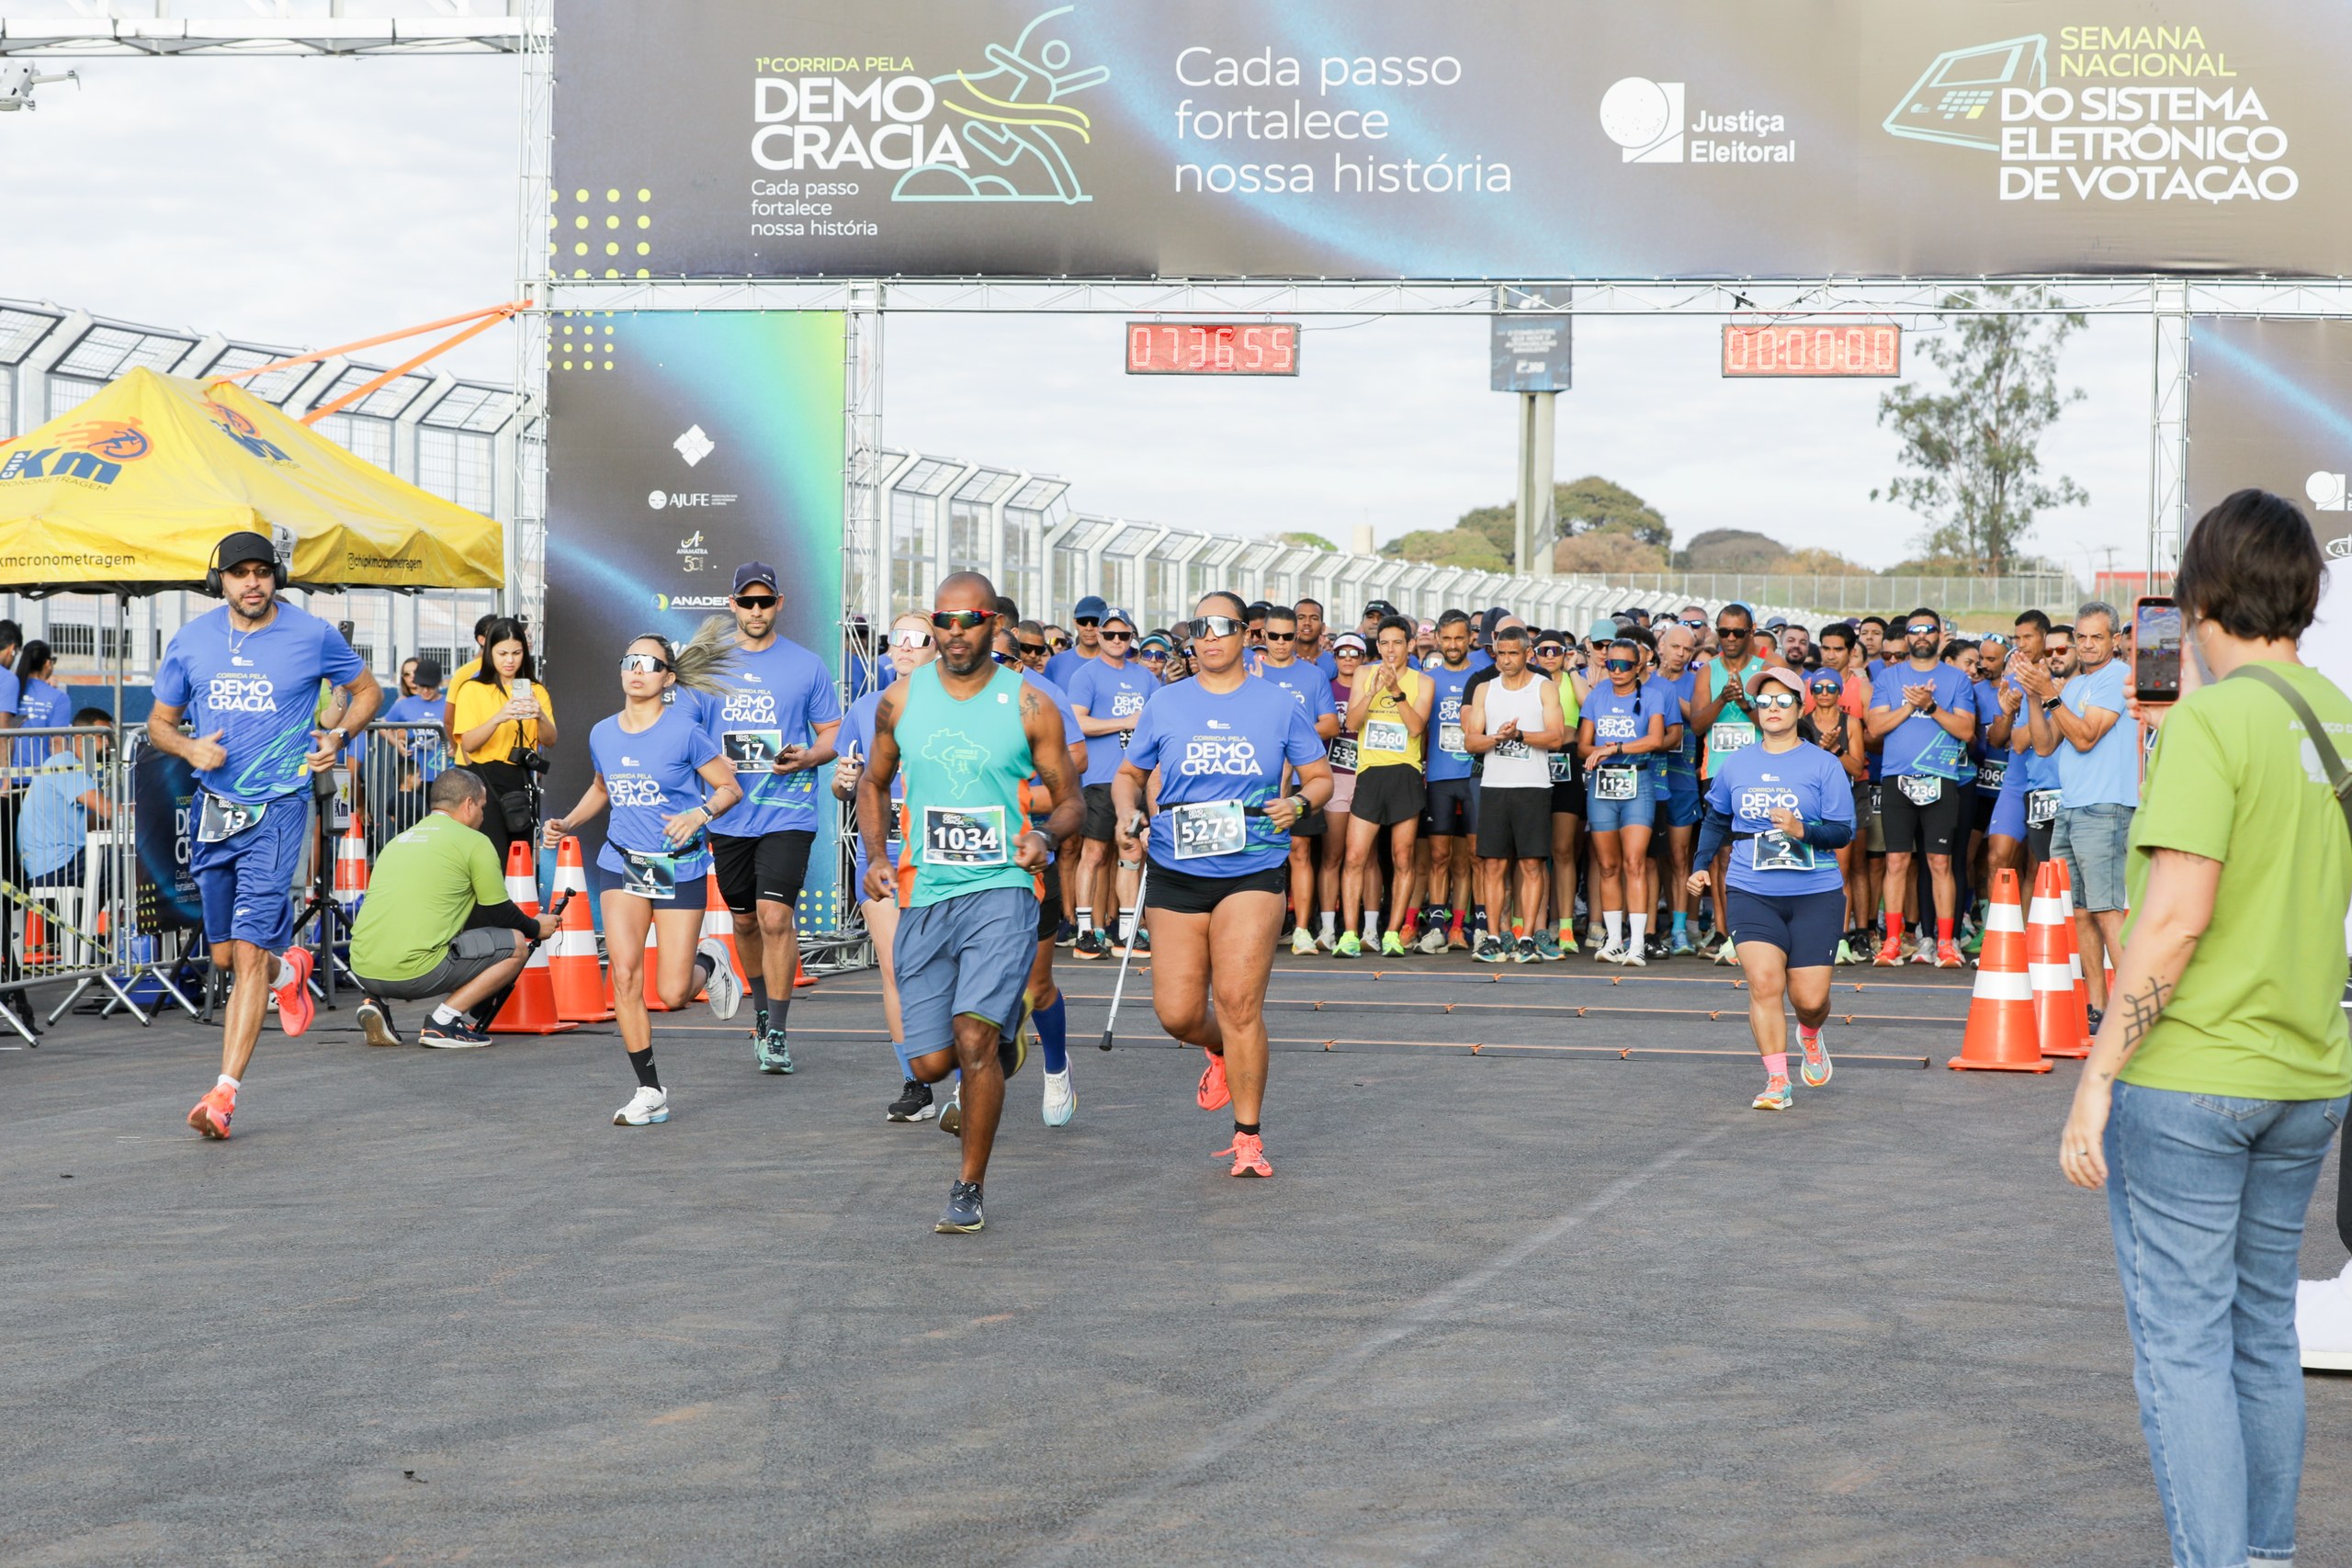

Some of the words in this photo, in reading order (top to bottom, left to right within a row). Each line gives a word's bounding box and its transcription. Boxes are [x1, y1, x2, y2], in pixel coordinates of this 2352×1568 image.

[2060, 26, 2205, 51] SEMANA
[865, 56, 915, 73] PELA
[1175, 46, 1301, 87] Cada
[1320, 54, 1462, 96] passo
[2059, 52, 2237, 77] NACIONAL
[754, 76, 935, 123] DEMO
[2001, 87, 2075, 121] DO
[2081, 87, 2269, 121] SISTEMA
[1175, 99, 1389, 140] fortalece
[1691, 110, 1785, 138] Justiça
[751, 124, 970, 171] CRACIA
[1690, 140, 1795, 163] Eleitoral
[2001, 123, 2289, 162] ELETRÔNICO
[1175, 164, 1314, 194] nossa
[1334, 152, 1512, 193] história
[1999, 166, 2060, 200] DE
[2066, 157, 2299, 204] VOTAÇÃO
[751, 179, 799, 196] Cada
[805, 183, 860, 200] passo
[751, 199, 832, 216] fortalece
[751, 222, 805, 235] nossa
[809, 219, 878, 235] história
[1728, 330, 1894, 369] 00:00:00
[670, 493, 710, 508] AJUFE
[209, 680, 274, 696] DEMO
[208, 694, 277, 712] CRACIA
[726, 694, 775, 709] DEMO
[1114, 695, 1145, 706] DEMO
[1440, 700, 1462, 712] DEM
[721, 708, 777, 724] CRACIA
[1597, 718, 1634, 728] DEMO
[1370, 730, 1402, 745] 5260
[1596, 728, 1636, 738] CRACIA
[1717, 733, 1751, 745] 1150
[741, 743, 764, 761] 17
[1186, 742, 1255, 760] DEMO
[1332, 746, 1358, 763] 533
[1181, 759, 1263, 776] CRACIA
[606, 780, 660, 795] DEMO
[1600, 777, 1633, 791] 1123
[1741, 793, 1799, 808] DEMO
[222, 810, 247, 829] 13
[1739, 807, 1804, 820] CRAA
[933, 827, 999, 851] 1034
[1182, 817, 1238, 844] 5273
[1779, 841, 1792, 857] 2
[642, 867, 656, 886] 4
